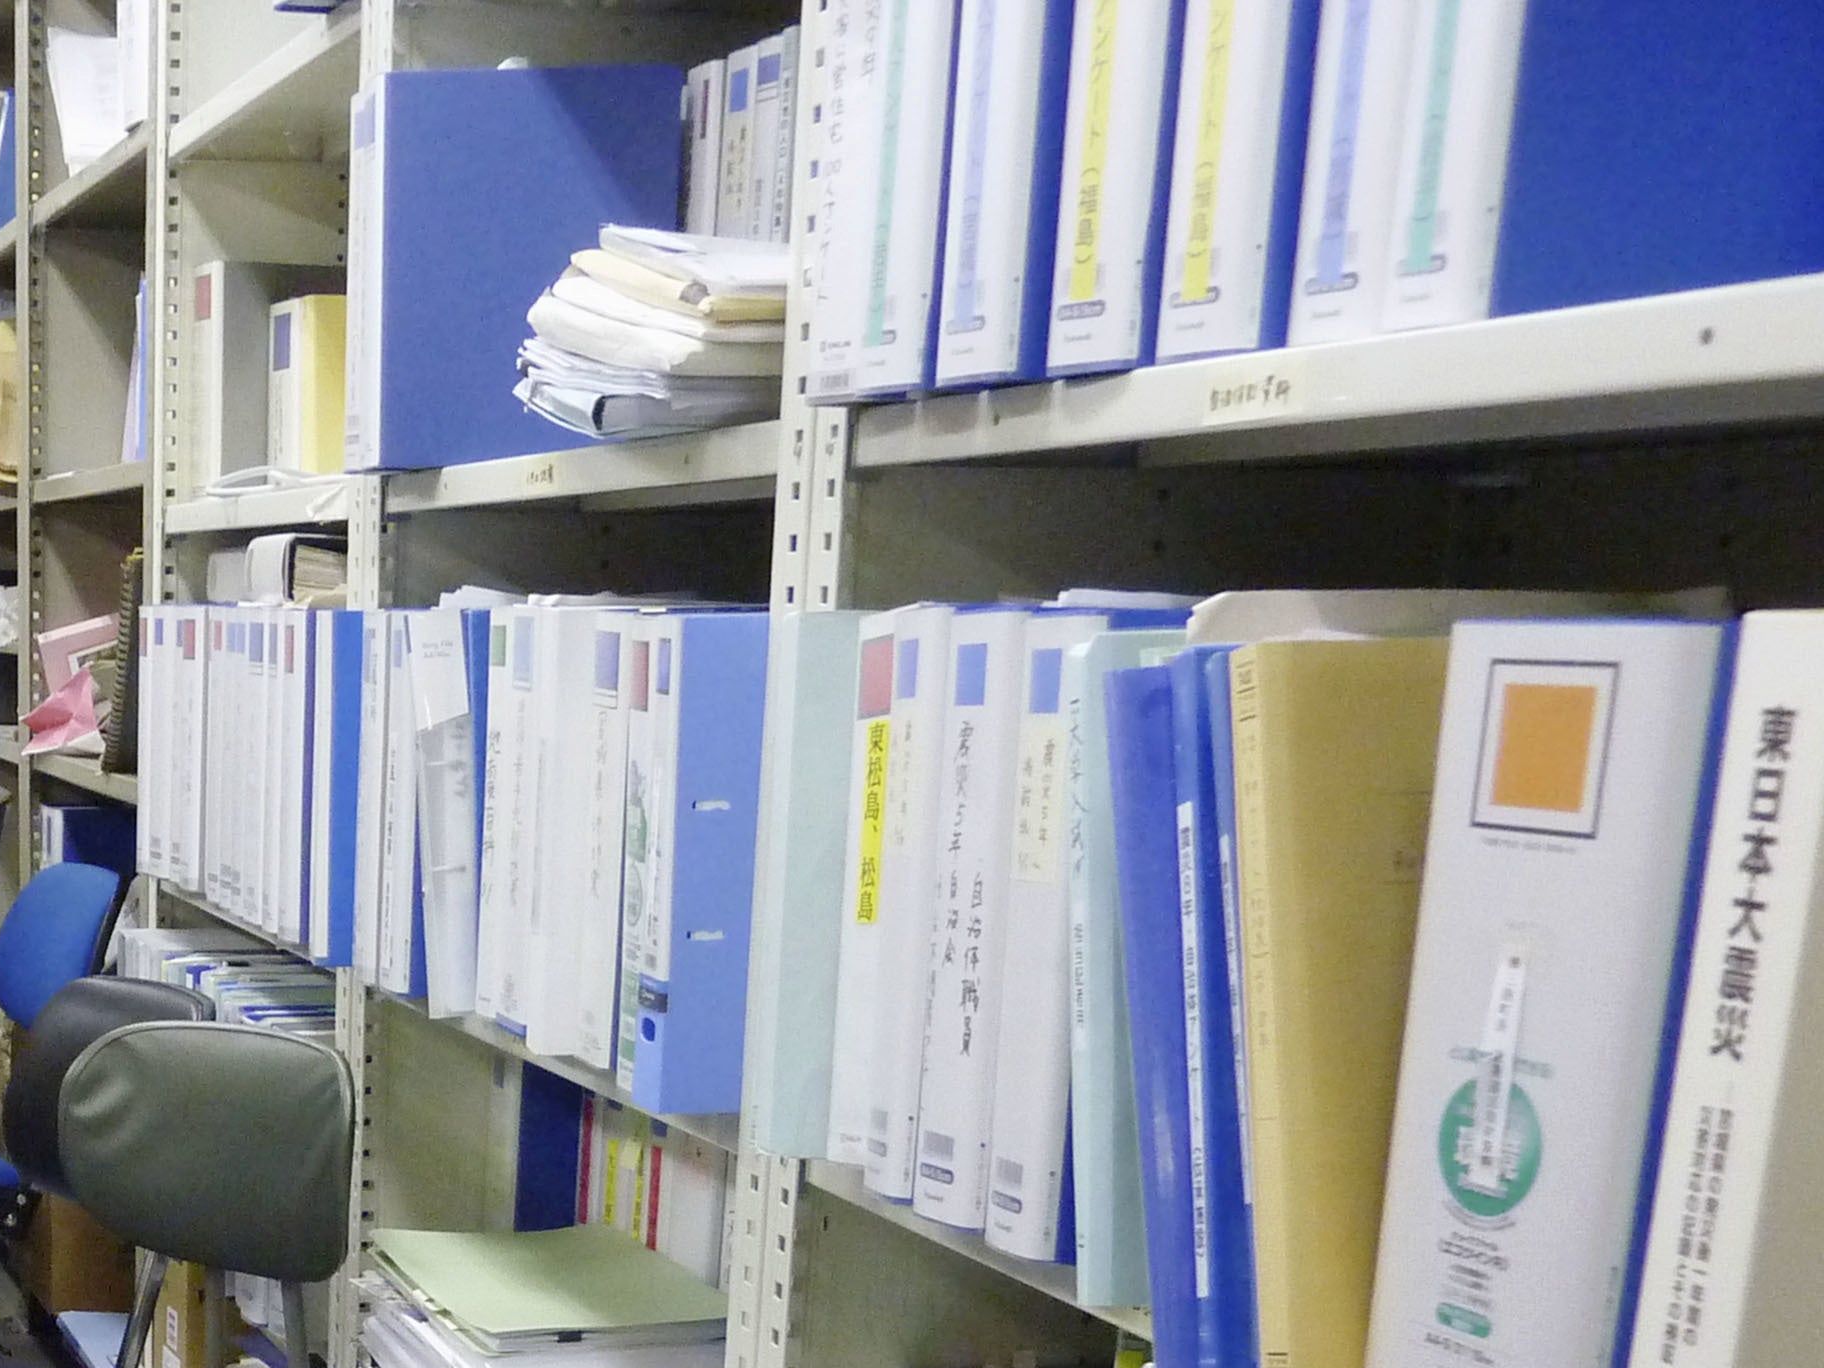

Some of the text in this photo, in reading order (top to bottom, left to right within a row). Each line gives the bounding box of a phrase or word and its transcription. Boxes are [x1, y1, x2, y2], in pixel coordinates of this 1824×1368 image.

[856, 856, 877, 922] 松島
[1707, 703, 1798, 1062] 東日本大震災
